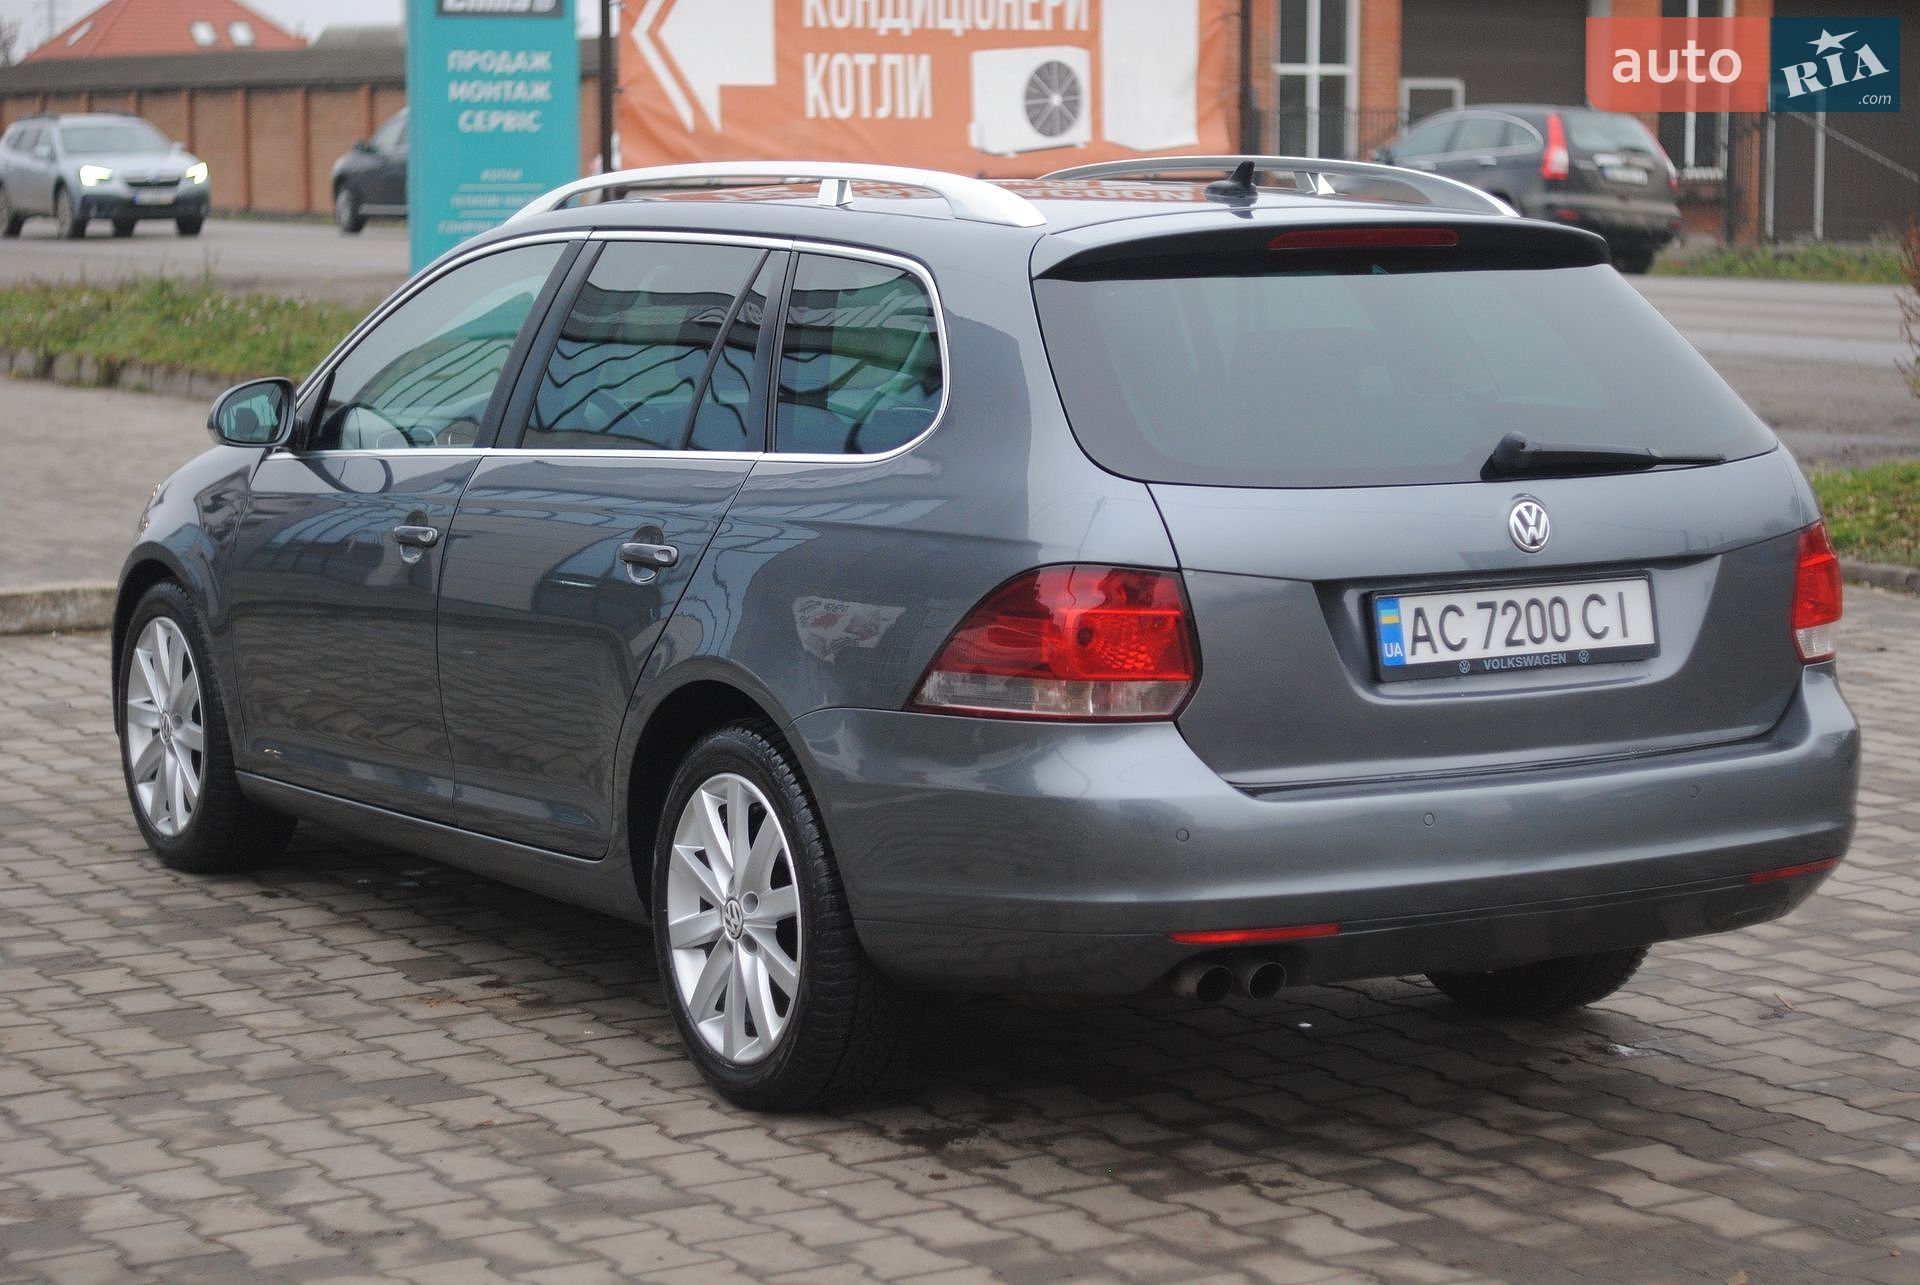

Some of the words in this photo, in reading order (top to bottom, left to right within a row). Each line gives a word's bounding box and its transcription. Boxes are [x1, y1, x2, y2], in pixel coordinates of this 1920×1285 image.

[447, 50, 552, 75] ПРОДАЖ
[447, 80, 552, 103] МОНТАЖ
[803, 52, 933, 119] КОТЛИ
[458, 109, 544, 133] СЕРВІС
[1410, 604, 1468, 656] AC
[1476, 596, 1571, 649] 7200
[1582, 591, 1629, 640] CI
[1384, 643, 1403, 658] UA
[1483, 653, 1567, 670] VOLKSWAGEN
